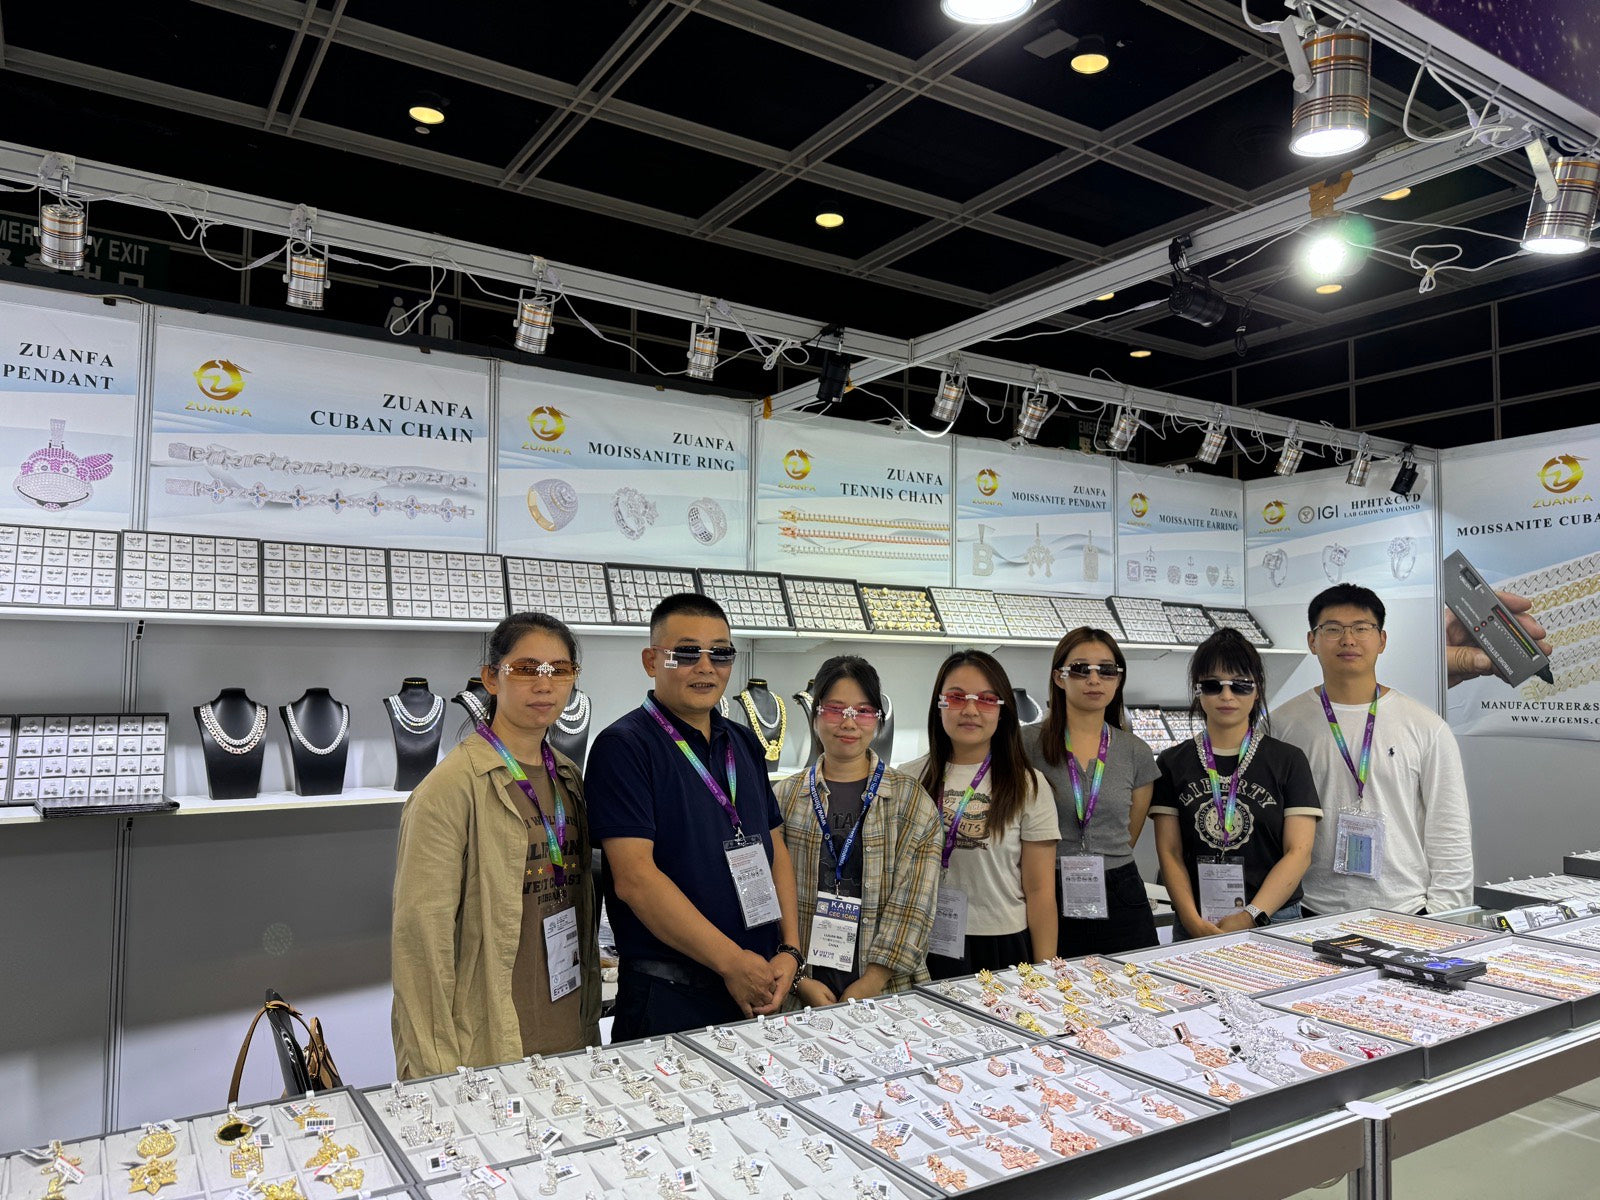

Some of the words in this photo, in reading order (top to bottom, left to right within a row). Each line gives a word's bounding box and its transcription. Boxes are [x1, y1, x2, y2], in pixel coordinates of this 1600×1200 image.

[109, 240, 149, 266] EXIT
[19, 342, 114, 368] ZUANFA
[3, 364, 114, 390] PENDANT
[185, 401, 252, 417] ZUANFA
[382, 393, 474, 420] ZUANFA
[310, 410, 392, 434] CUBAN
[401, 421, 474, 444] CHAIN
[521, 441, 572, 455] ZUANFA
[673, 432, 735, 452] ZUANFA
[588, 441, 692, 467] MOISSANITE
[696, 455, 735, 472] RING
[887, 468, 943, 486] ZUANFA
[840, 483, 893, 500] TENNIS
[898, 489, 943, 505] CHAIN
[1012, 491, 1066, 506] MOISSANITE
[1069, 497, 1106, 510] PENDANT
[1073, 485, 1106, 498] ZUANFA
[1351, 493, 1421, 510] HPHT&CVD
[1358, 508, 1385, 517] GROWN
[1386, 504, 1421, 513] DIAMOND
[1532, 494, 1594, 509] ZUANFA
[1209, 508, 1238, 519] ZUANFA
[1318, 505, 1338, 520] IGI
[1158, 514, 1204, 529] MOISSANITE
[1206, 520, 1239, 532] EARRING
[1457, 517, 1552, 537] MOISSANITE
[1481, 701, 1600, 711] MANUFACTURER&S
[831, 901, 859, 911] KARP
